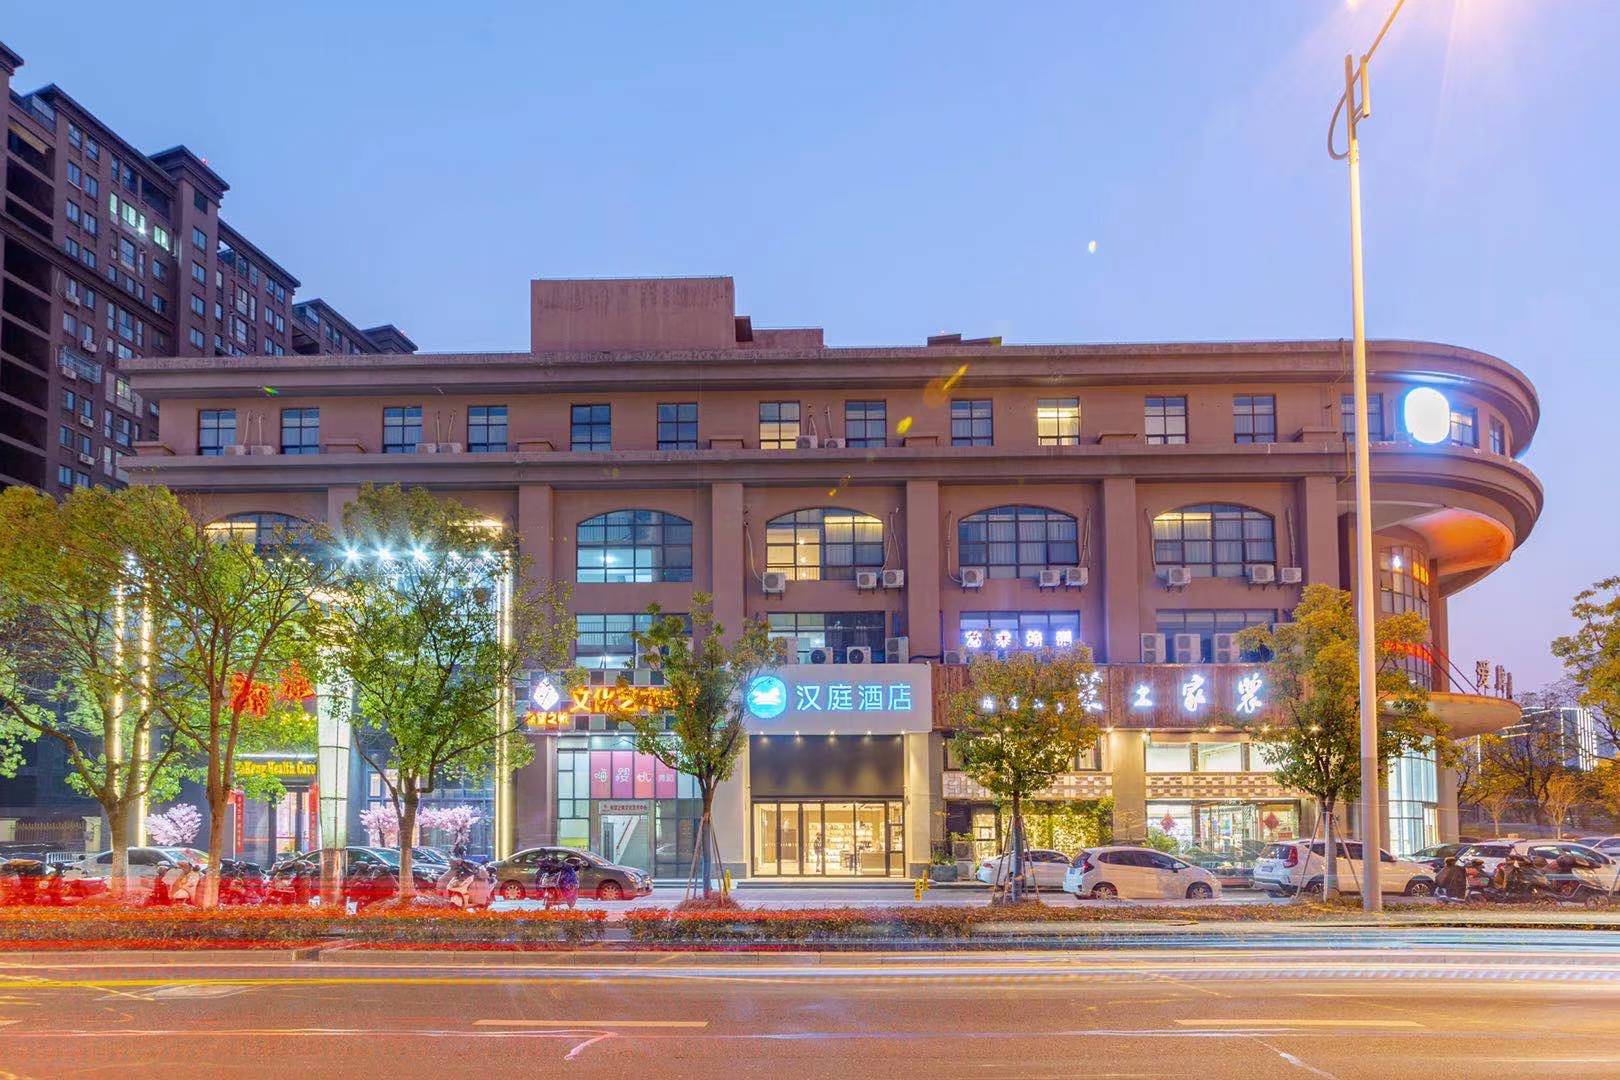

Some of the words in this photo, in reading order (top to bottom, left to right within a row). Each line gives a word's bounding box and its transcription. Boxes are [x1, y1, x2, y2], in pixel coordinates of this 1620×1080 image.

[796, 684, 912, 711] 汉庭酒店
[267, 761, 296, 775] Health
